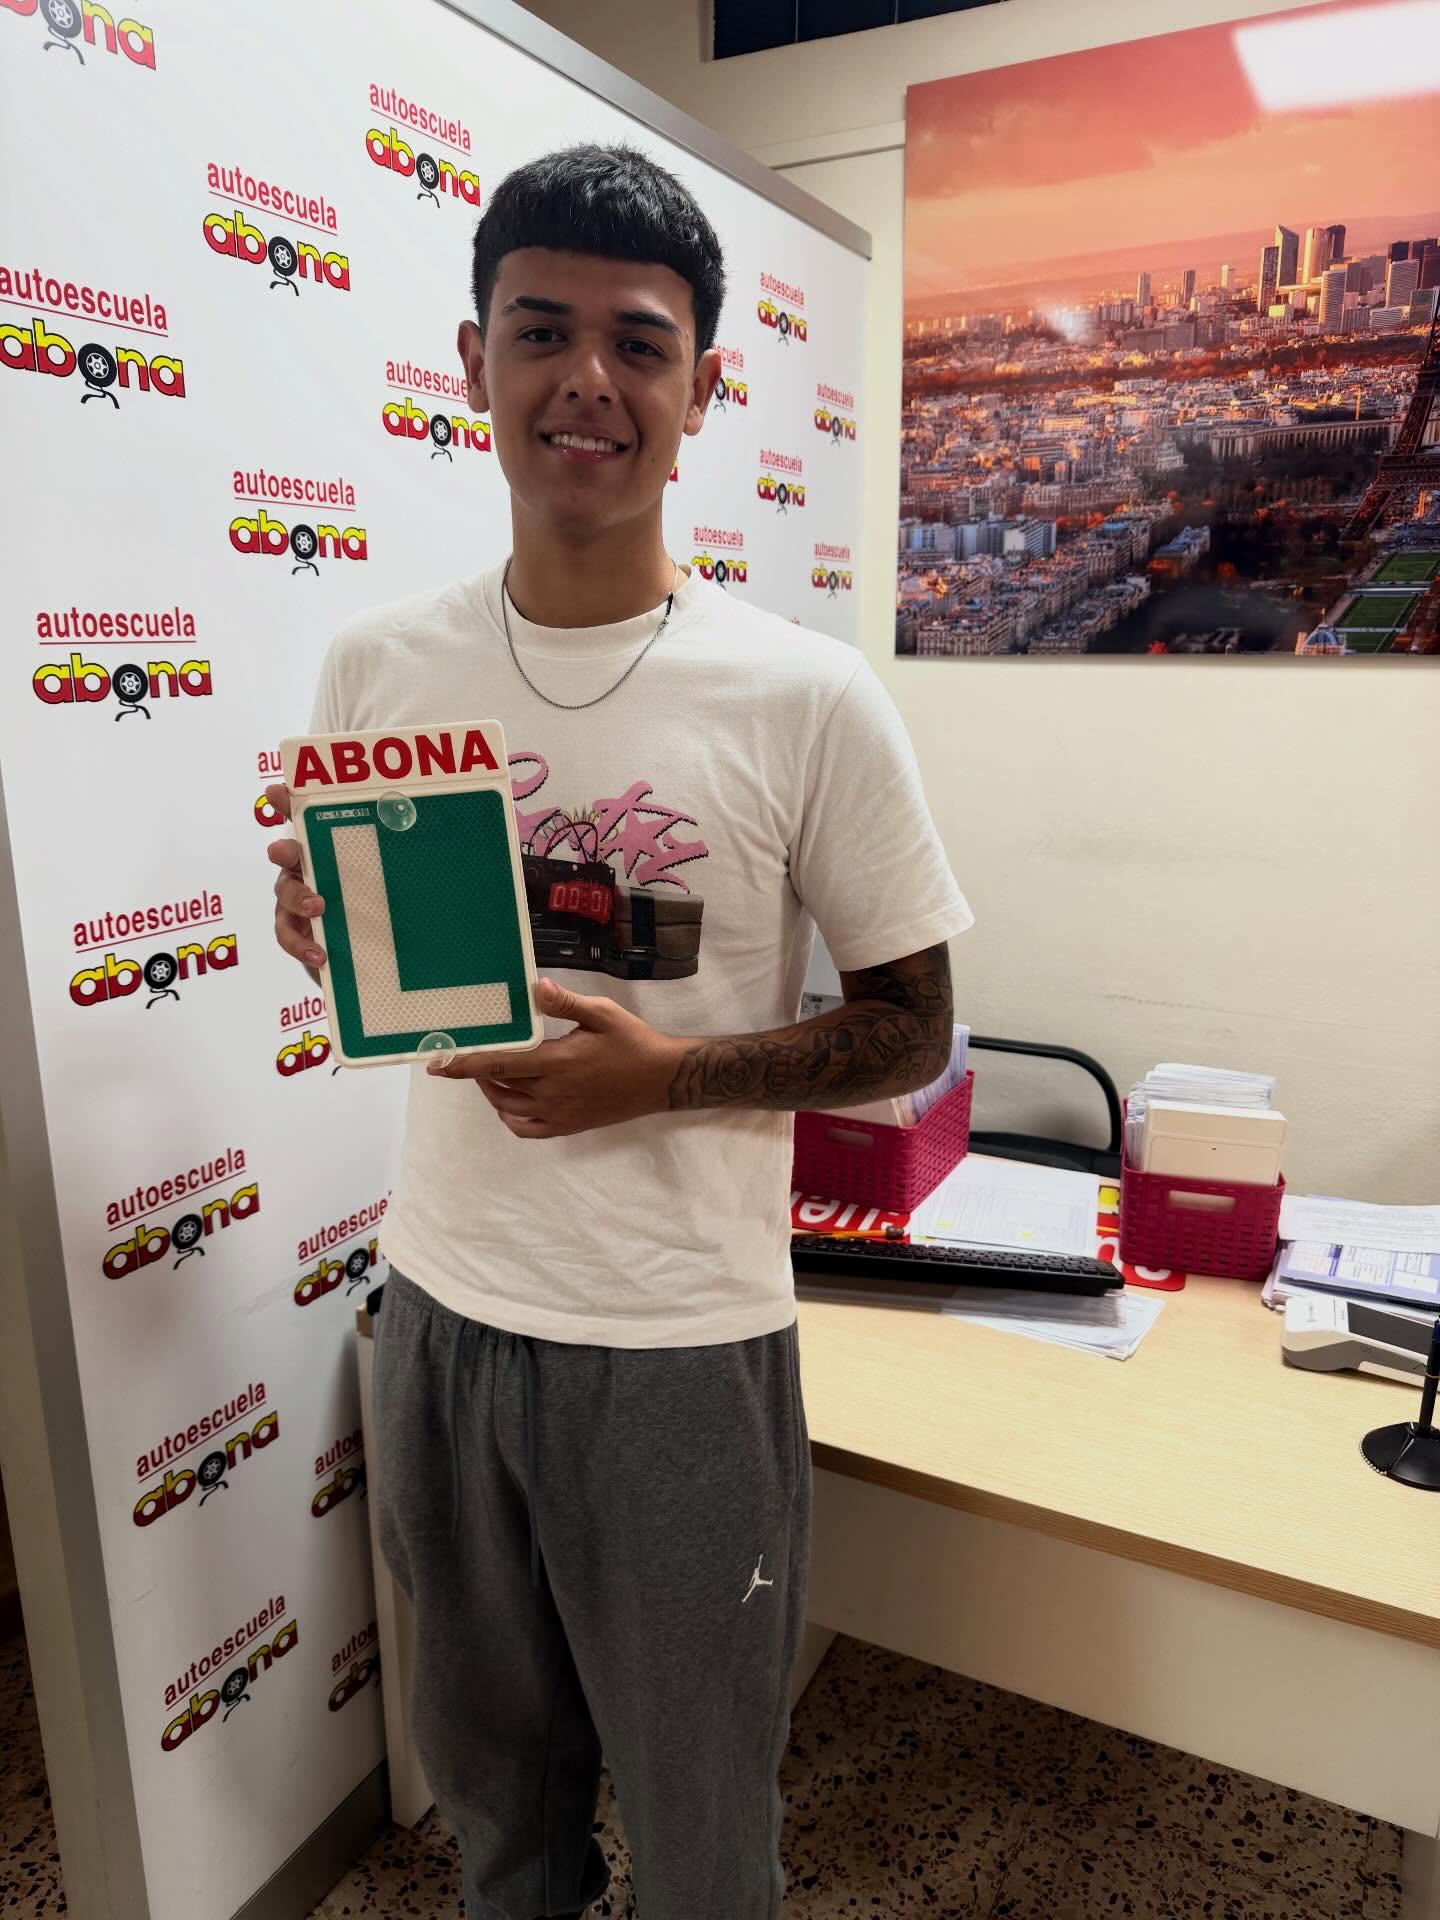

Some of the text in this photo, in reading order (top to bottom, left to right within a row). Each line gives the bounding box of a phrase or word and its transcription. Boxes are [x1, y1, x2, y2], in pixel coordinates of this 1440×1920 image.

[369, 83, 471, 150] autoescuela
[207, 162, 337, 230] autoescuela
[0, 267, 168, 331] autoescuela
[759, 271, 805, 306] autoescuela
[385, 360, 469, 399] autoescue
[233, 468, 356, 506] autoescuela
[759, 448, 803, 473] autoescuela
[693, 523, 744, 546] autoescuela
[36, 606, 196, 638] autoescuela
[293, 729, 500, 788] ABONA
[73, 890, 223, 948] autoescuela
[331, 823, 513, 1038] L
[106, 1147, 247, 1226] autoescuela
[298, 1190, 392, 1261] autoescue
[137, 1381, 267, 1477] autoescuela
[163, 1594, 287, 1706] autoescuela
